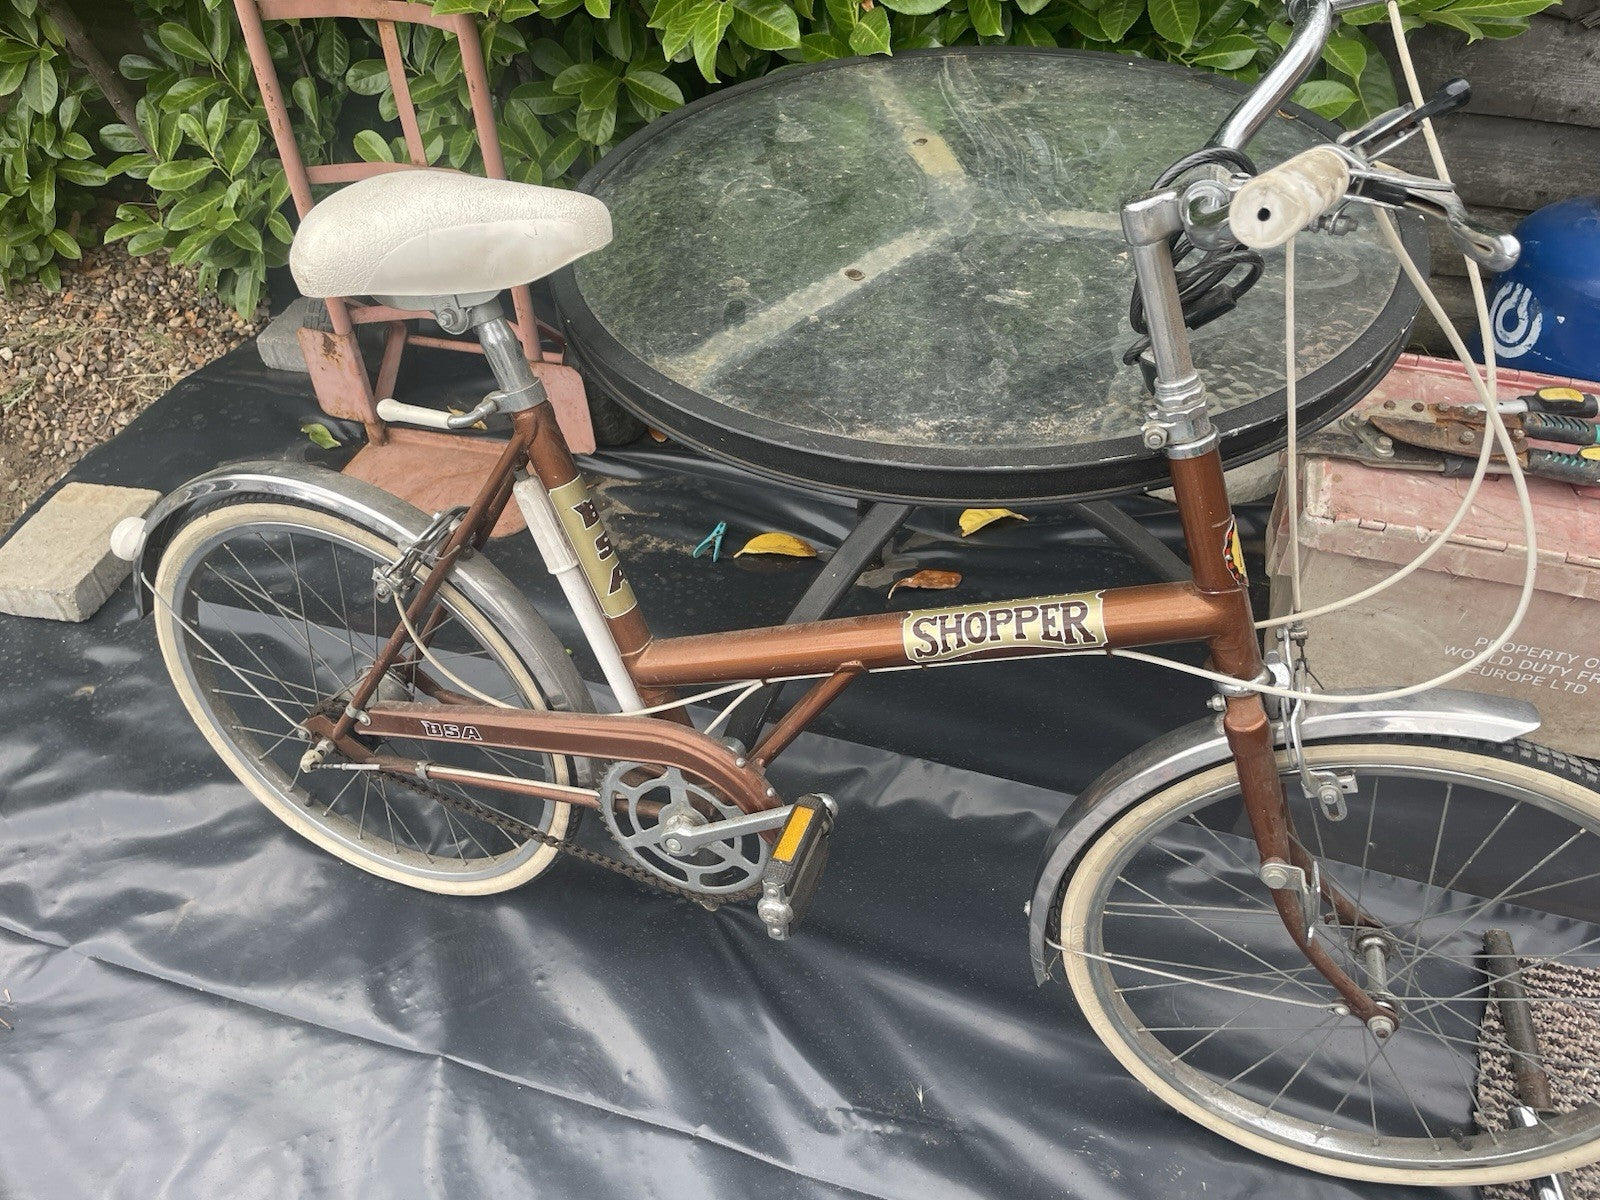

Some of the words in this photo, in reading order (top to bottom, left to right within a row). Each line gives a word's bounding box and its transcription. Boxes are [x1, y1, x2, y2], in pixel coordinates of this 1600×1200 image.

[911, 600, 1097, 657] SHOPPER
[1444, 645, 1513, 666] WOLD
[1518, 659, 1573, 677] DUTY
[1584, 657, 1600, 669] O
[1467, 664, 1546, 687] EUROPE
[1549, 679, 1588, 694] LTD
[420, 719, 483, 741] BSA
